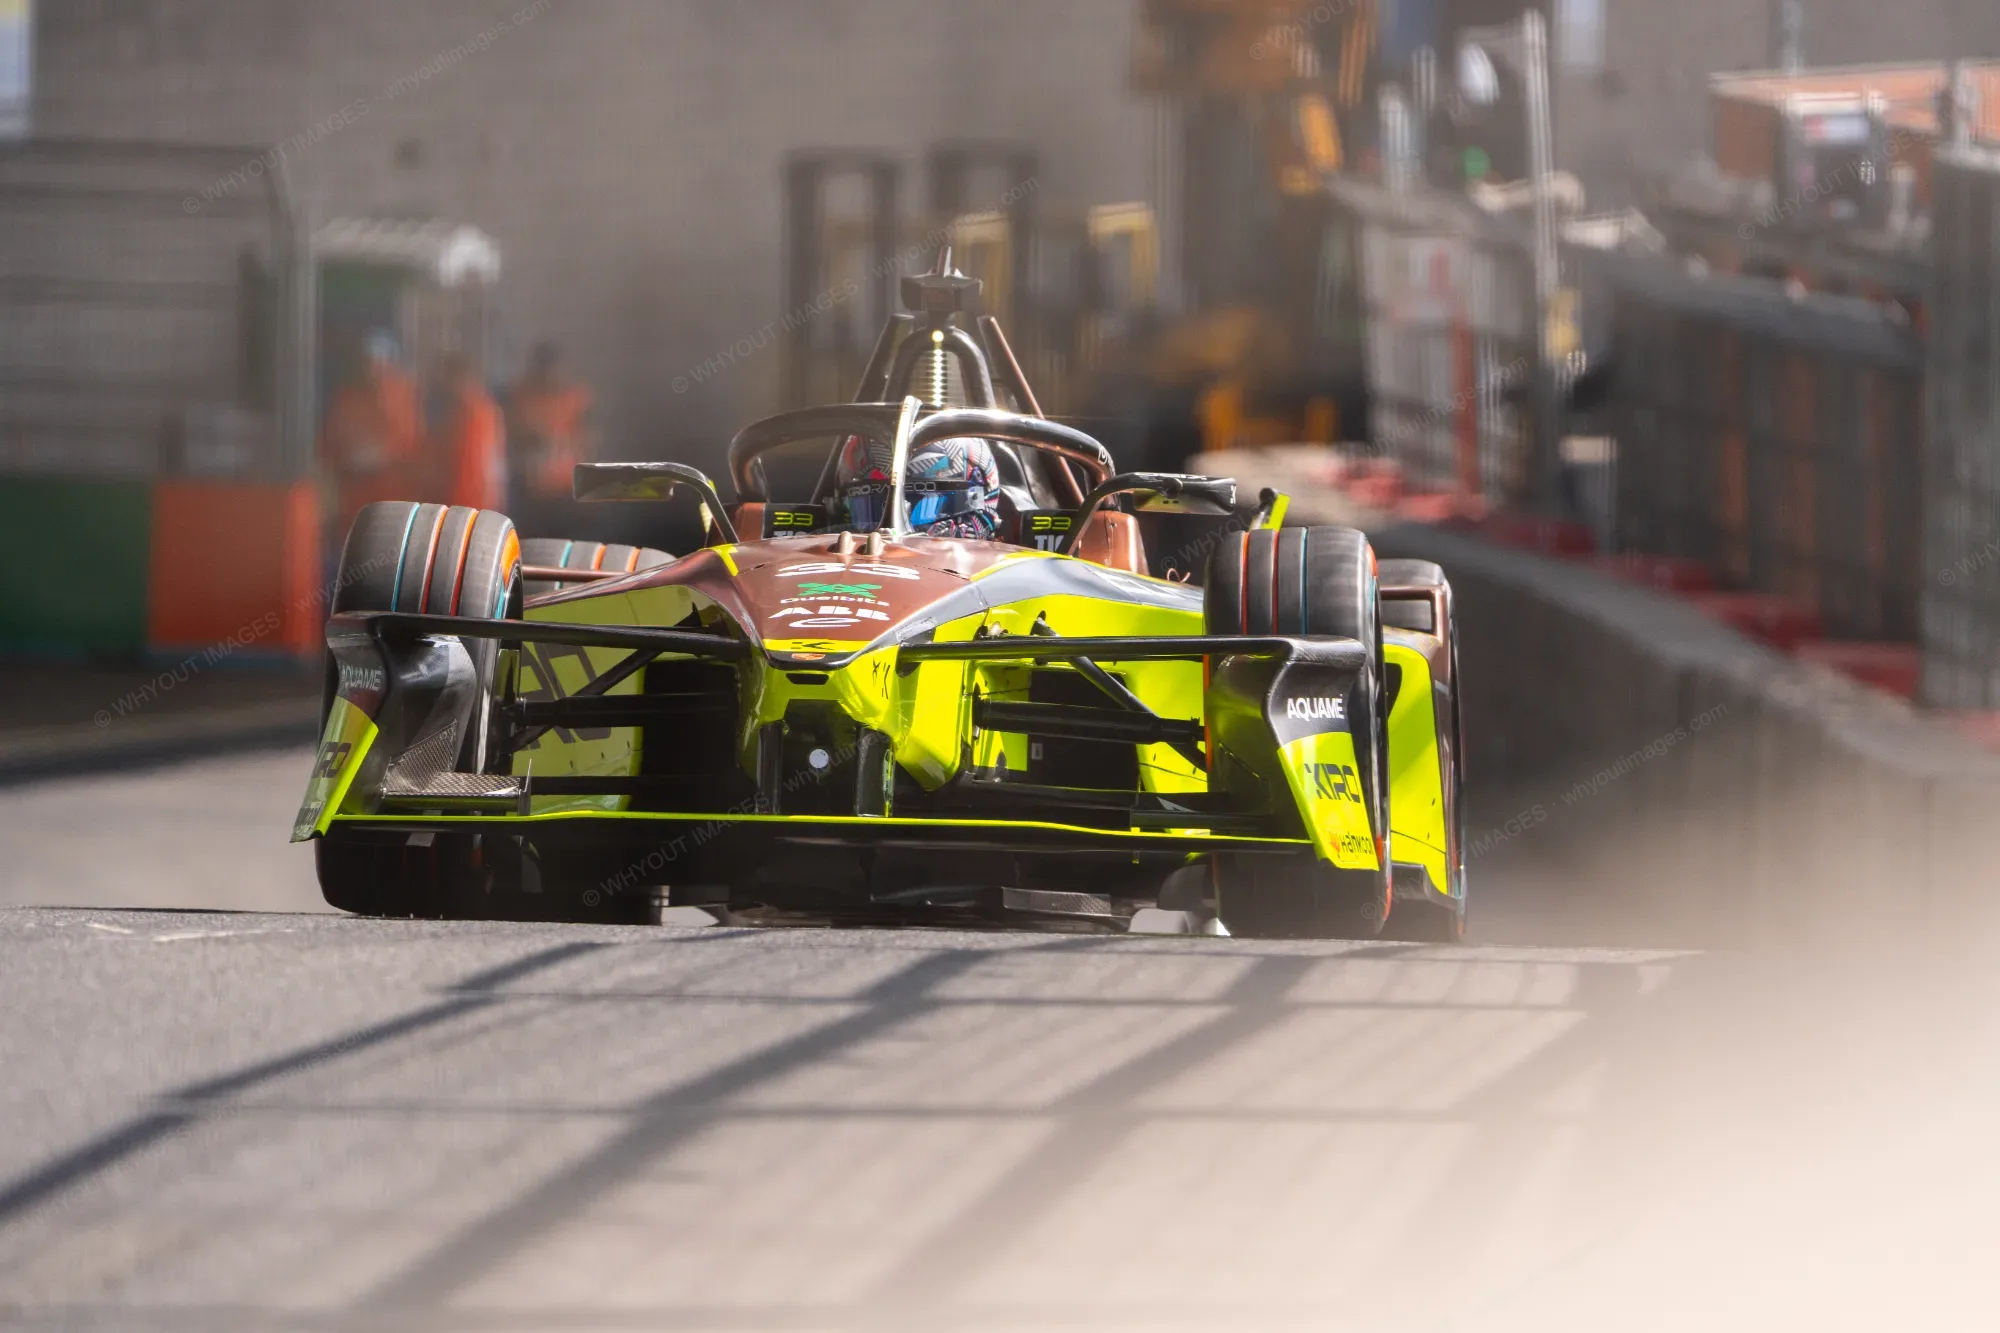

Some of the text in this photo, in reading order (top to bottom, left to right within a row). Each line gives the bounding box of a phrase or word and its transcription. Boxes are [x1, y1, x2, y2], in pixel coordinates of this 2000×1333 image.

[772, 512, 814, 526] 33
[1031, 516, 1072, 530] 33
[774, 562, 921, 580] 33
[768, 605, 890, 621] ABB
[1286, 697, 1344, 722] AQUAME
